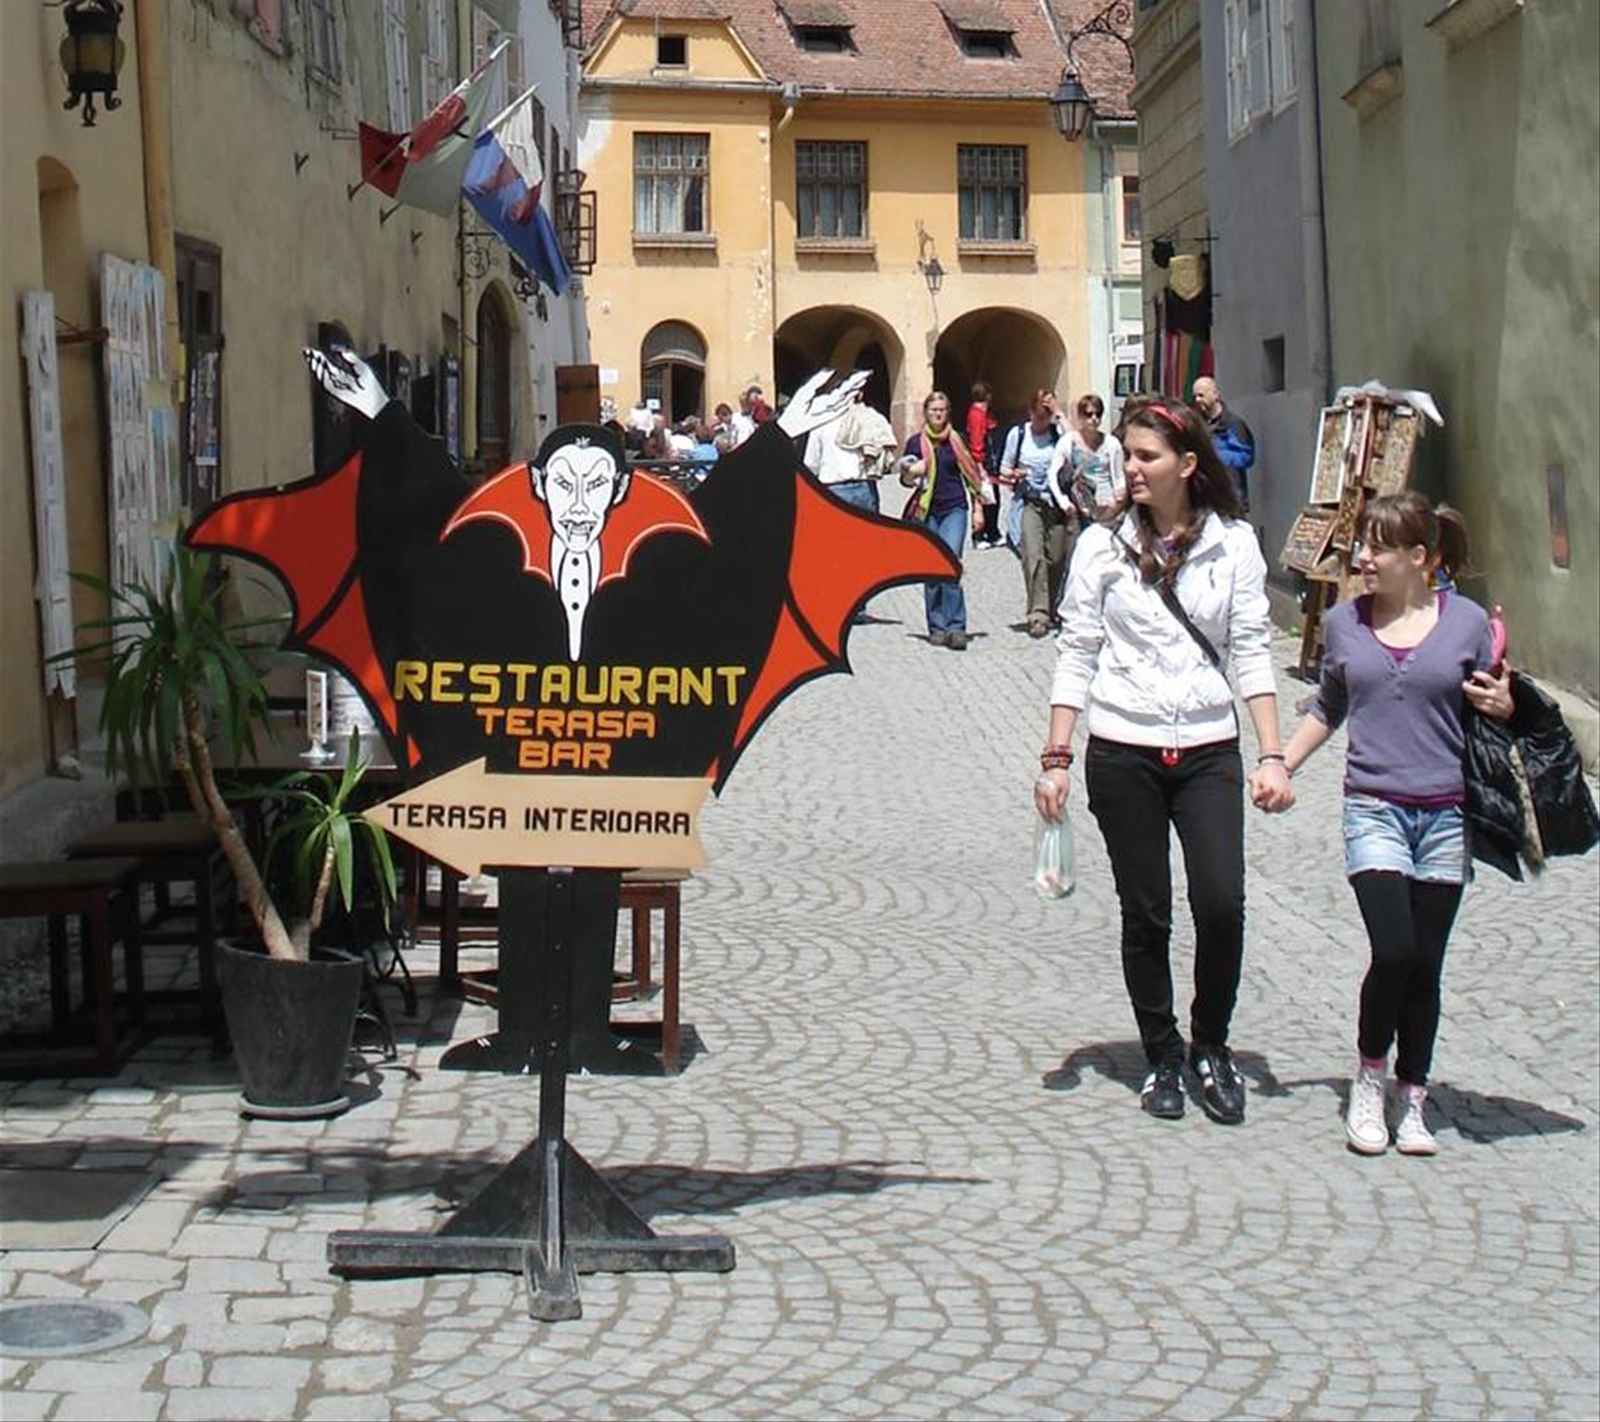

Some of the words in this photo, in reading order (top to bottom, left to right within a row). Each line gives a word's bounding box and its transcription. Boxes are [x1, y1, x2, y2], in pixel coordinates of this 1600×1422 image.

[394, 660, 747, 706] RESTAURANT
[476, 707, 656, 739] TERASA
[519, 741, 612, 770] BAR
[387, 803, 507, 830] TERASA
[524, 807, 691, 836] INTERIOARA
